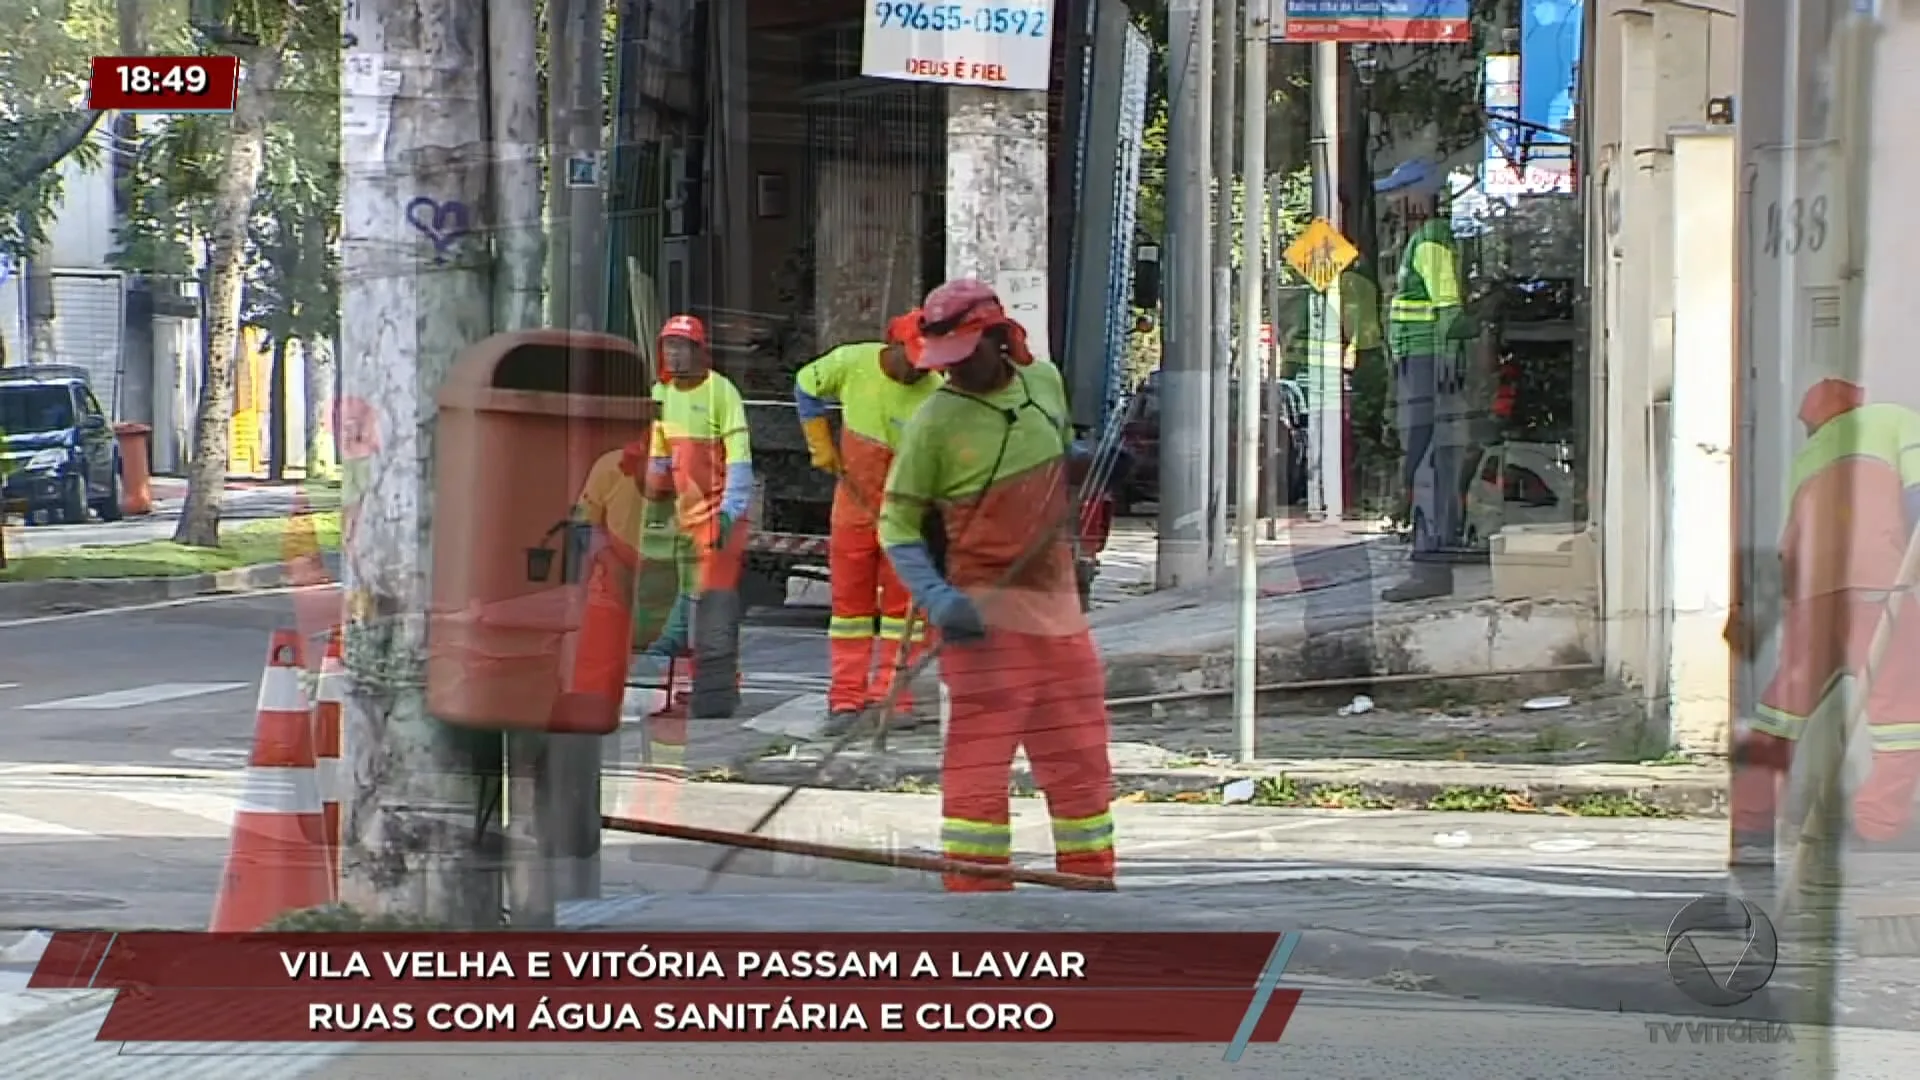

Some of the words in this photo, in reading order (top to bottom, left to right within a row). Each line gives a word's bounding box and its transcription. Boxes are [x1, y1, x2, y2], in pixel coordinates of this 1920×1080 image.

[874, 1, 1045, 37] 99655-0592
[905, 57, 949, 77] DEUS
[953, 56, 966, 78] É
[970, 63, 1007, 81] FIEL
